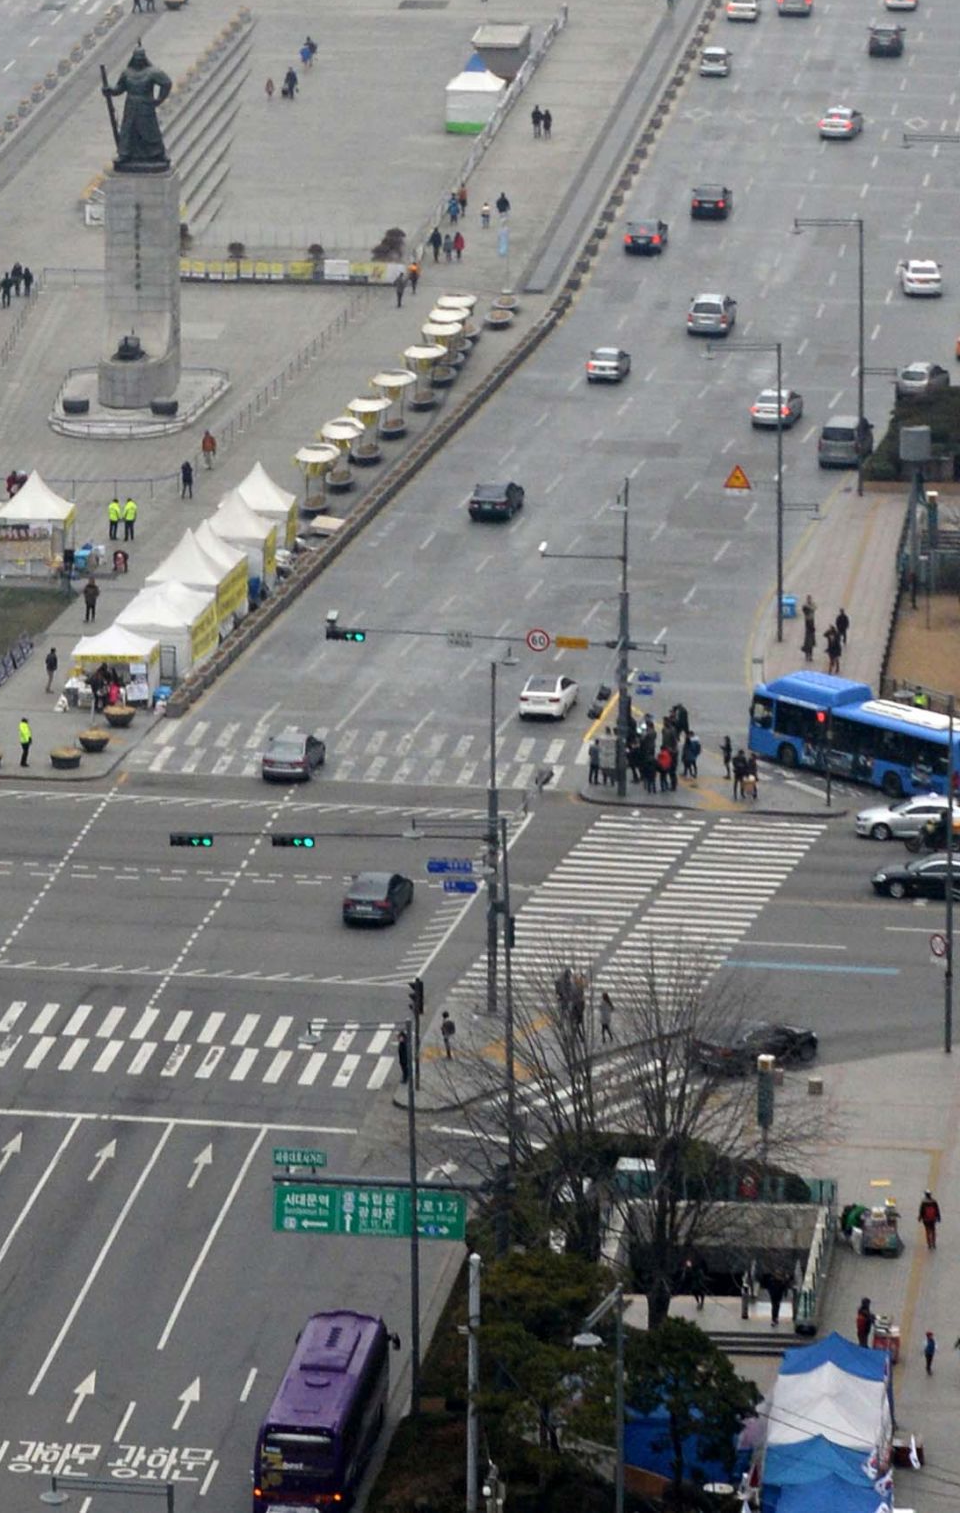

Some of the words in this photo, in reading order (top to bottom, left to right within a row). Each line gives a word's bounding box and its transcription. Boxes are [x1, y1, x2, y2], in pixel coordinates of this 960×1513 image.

[531, 634, 546, 647] 60
[283, 1192, 330, 1207] 서대문역
[358, 1206, 395, 1220] 광화문
[7, 1440, 102, 1477] 광화문
[106, 1444, 214, 1482] 광화문
